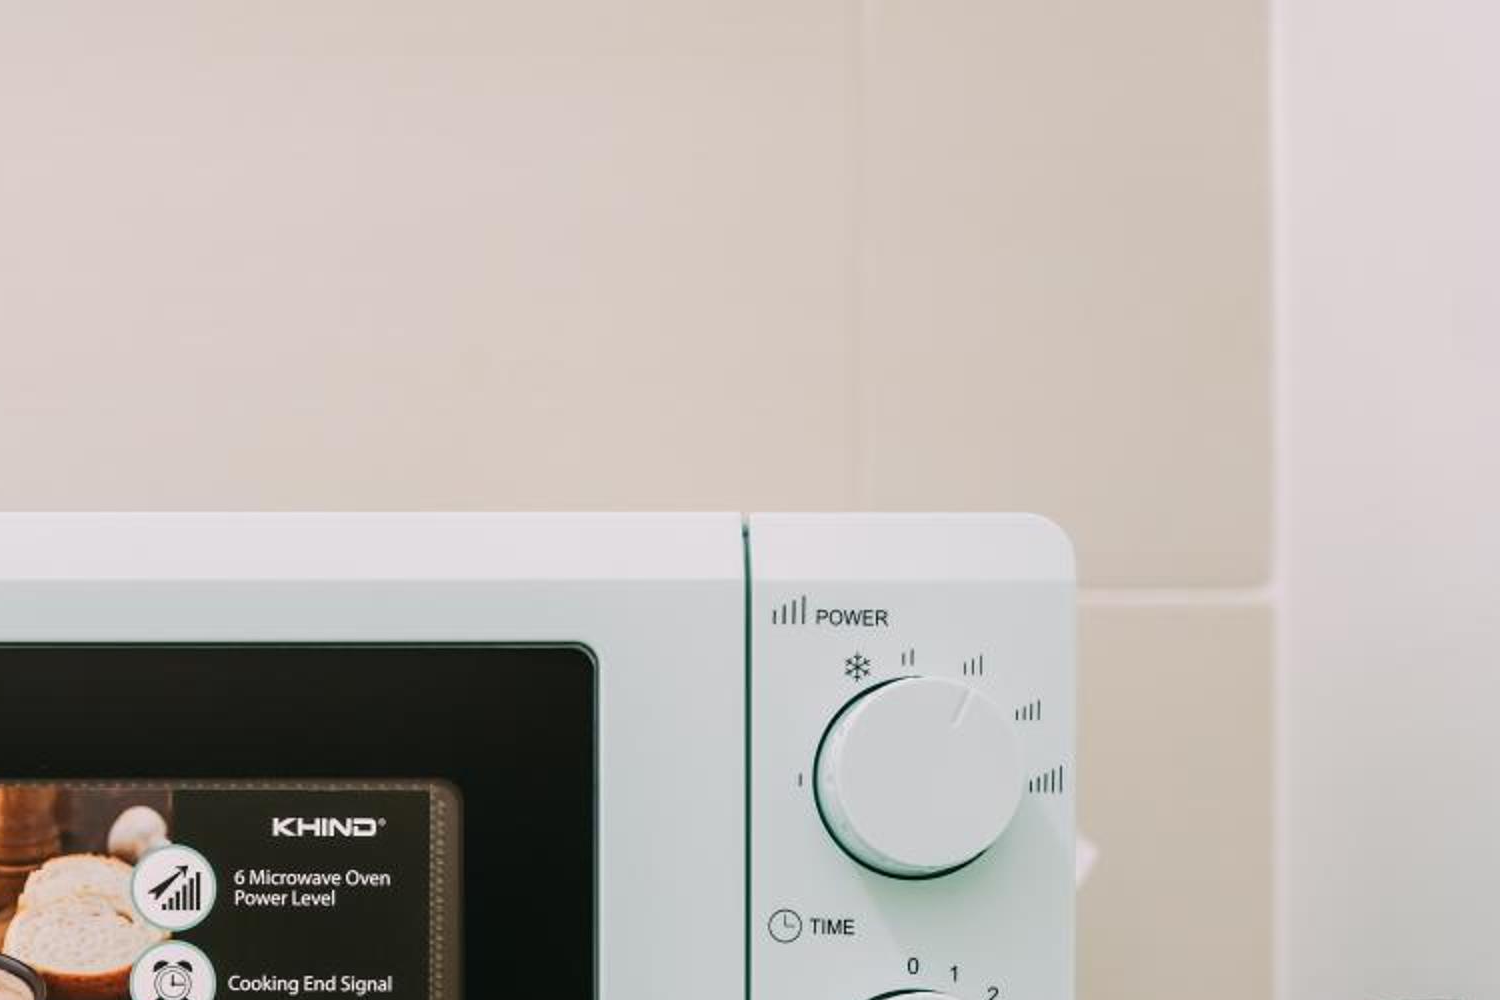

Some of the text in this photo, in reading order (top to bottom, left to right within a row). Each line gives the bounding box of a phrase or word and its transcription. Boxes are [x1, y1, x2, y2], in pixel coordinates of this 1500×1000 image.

[815, 609, 889, 627] POWER
[271, 816, 378, 838] KHIND
[233, 868, 391, 886] 6 Microwave Oven
[234, 890, 336, 907] Power Level
[809, 918, 856, 936] TIME
[906, 957, 920, 975] 0
[950, 964, 959, 982] 1
[227, 974, 393, 996] Cooking End Signal
